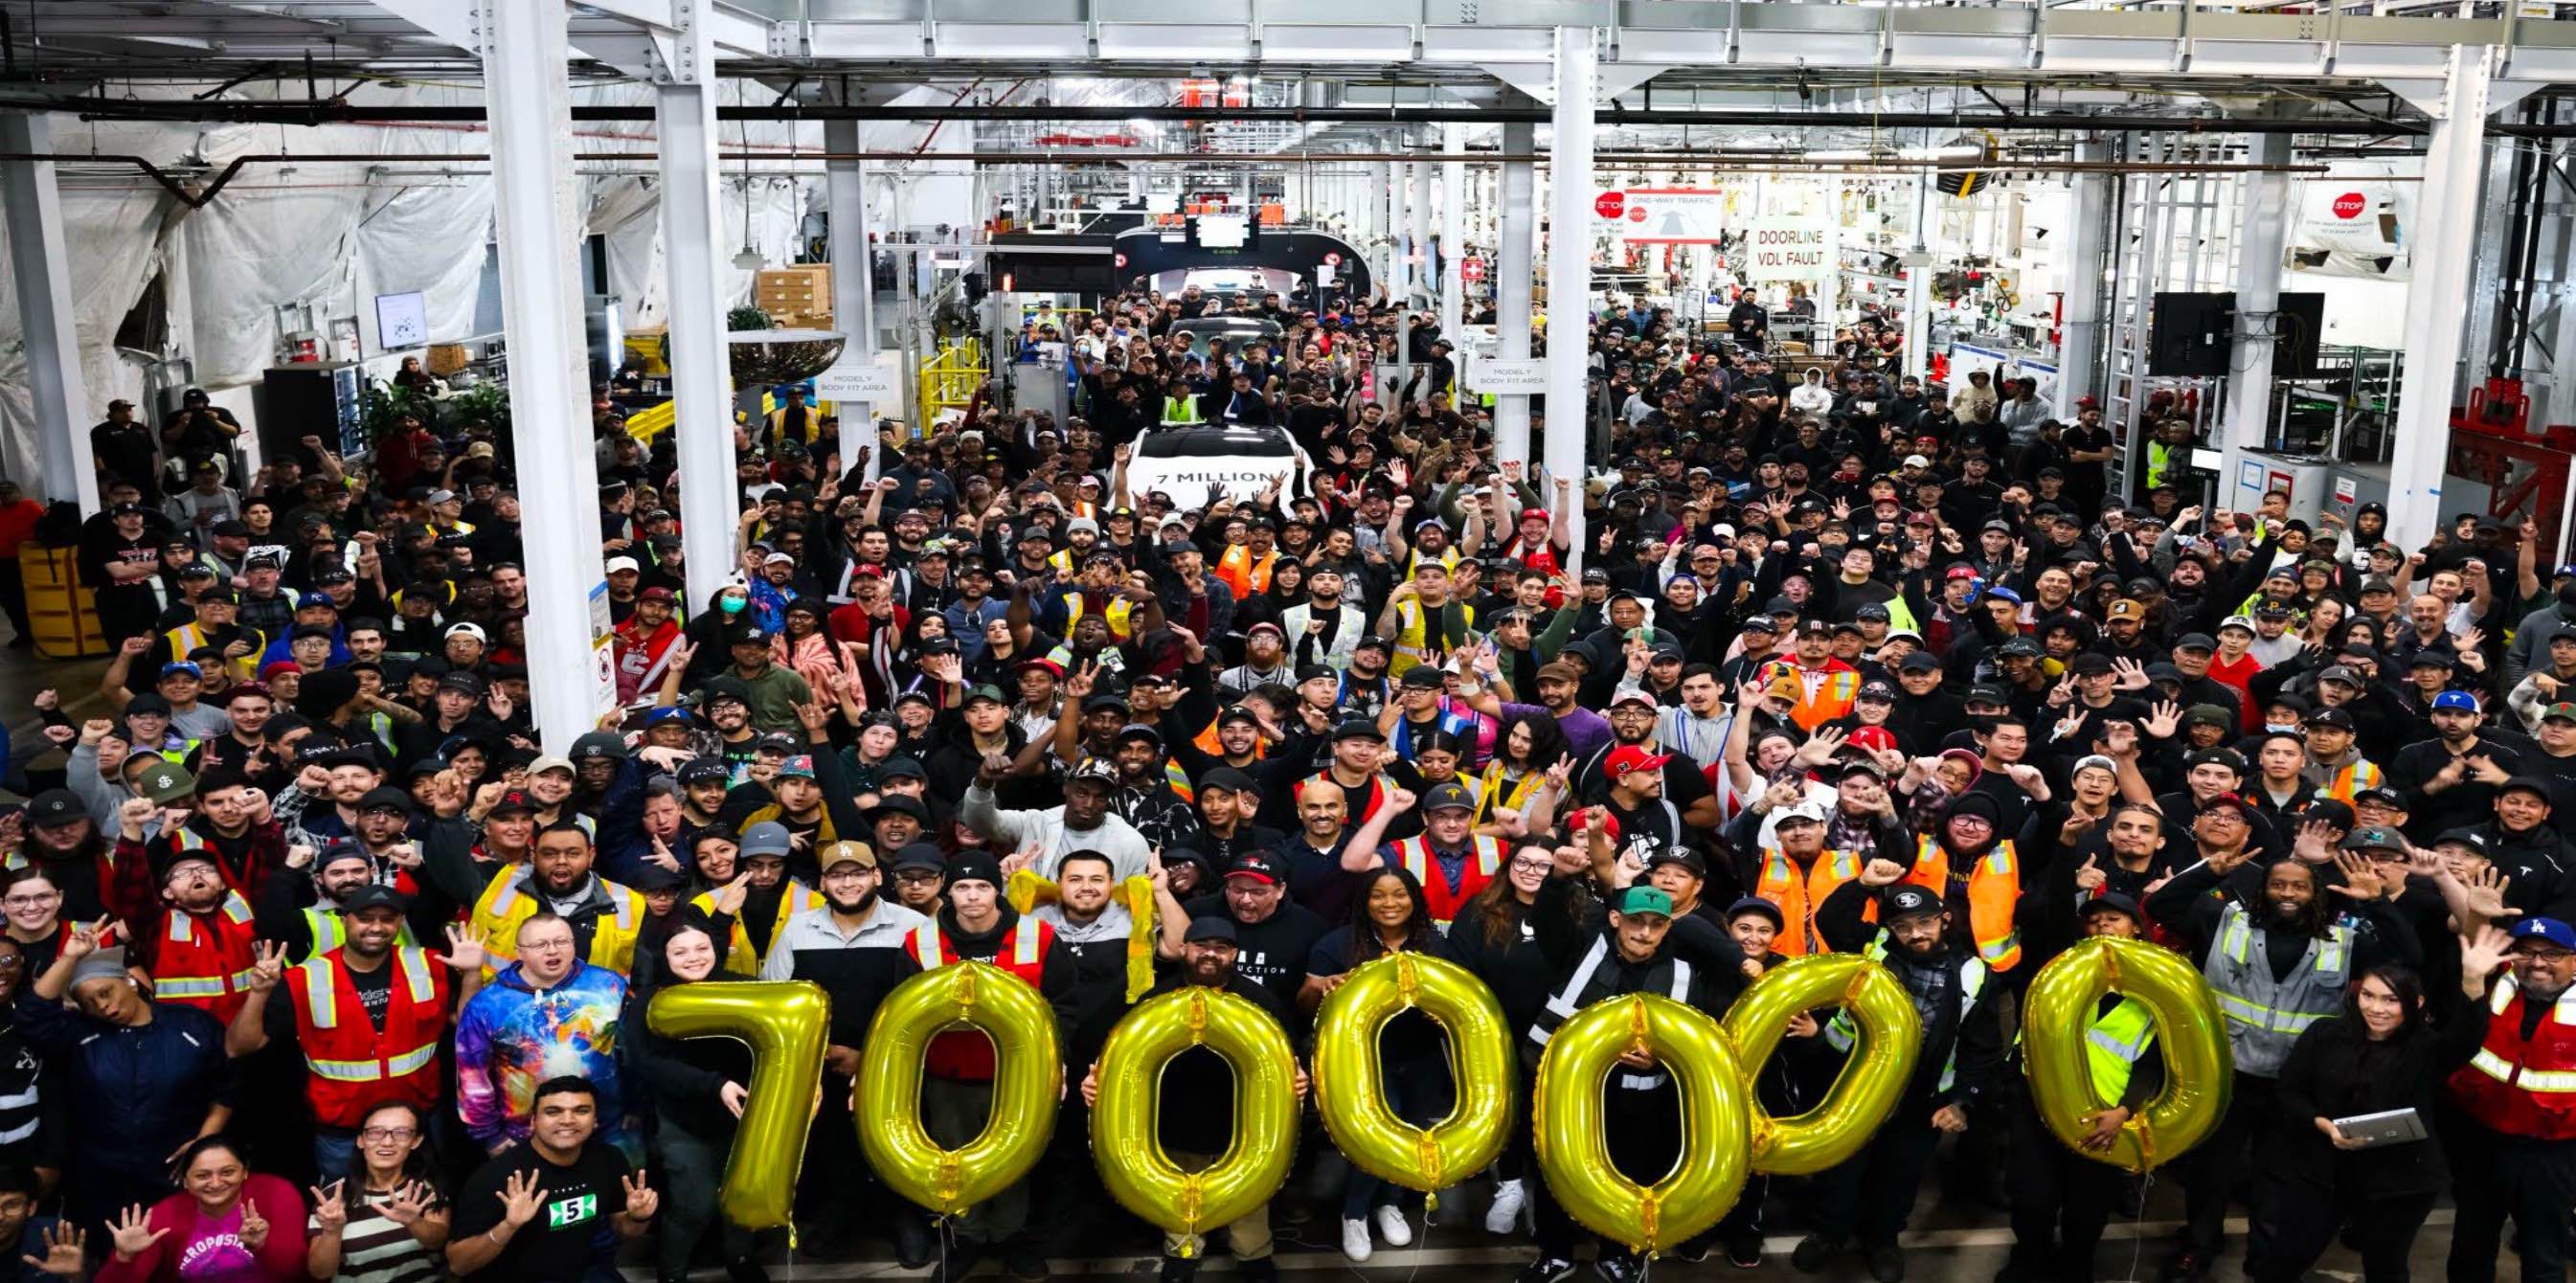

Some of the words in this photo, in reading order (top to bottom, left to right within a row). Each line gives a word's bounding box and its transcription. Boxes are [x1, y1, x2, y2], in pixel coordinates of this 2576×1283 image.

[1758, 230, 1823, 245] DOORLINE
[1757, 252, 1783, 266] VDL
[1787, 251, 1823, 265] FAULT
[1157, 475, 1168, 484] 7
[1177, 472, 1274, 484] MILLION
[566, 1200, 579, 1221] 5
